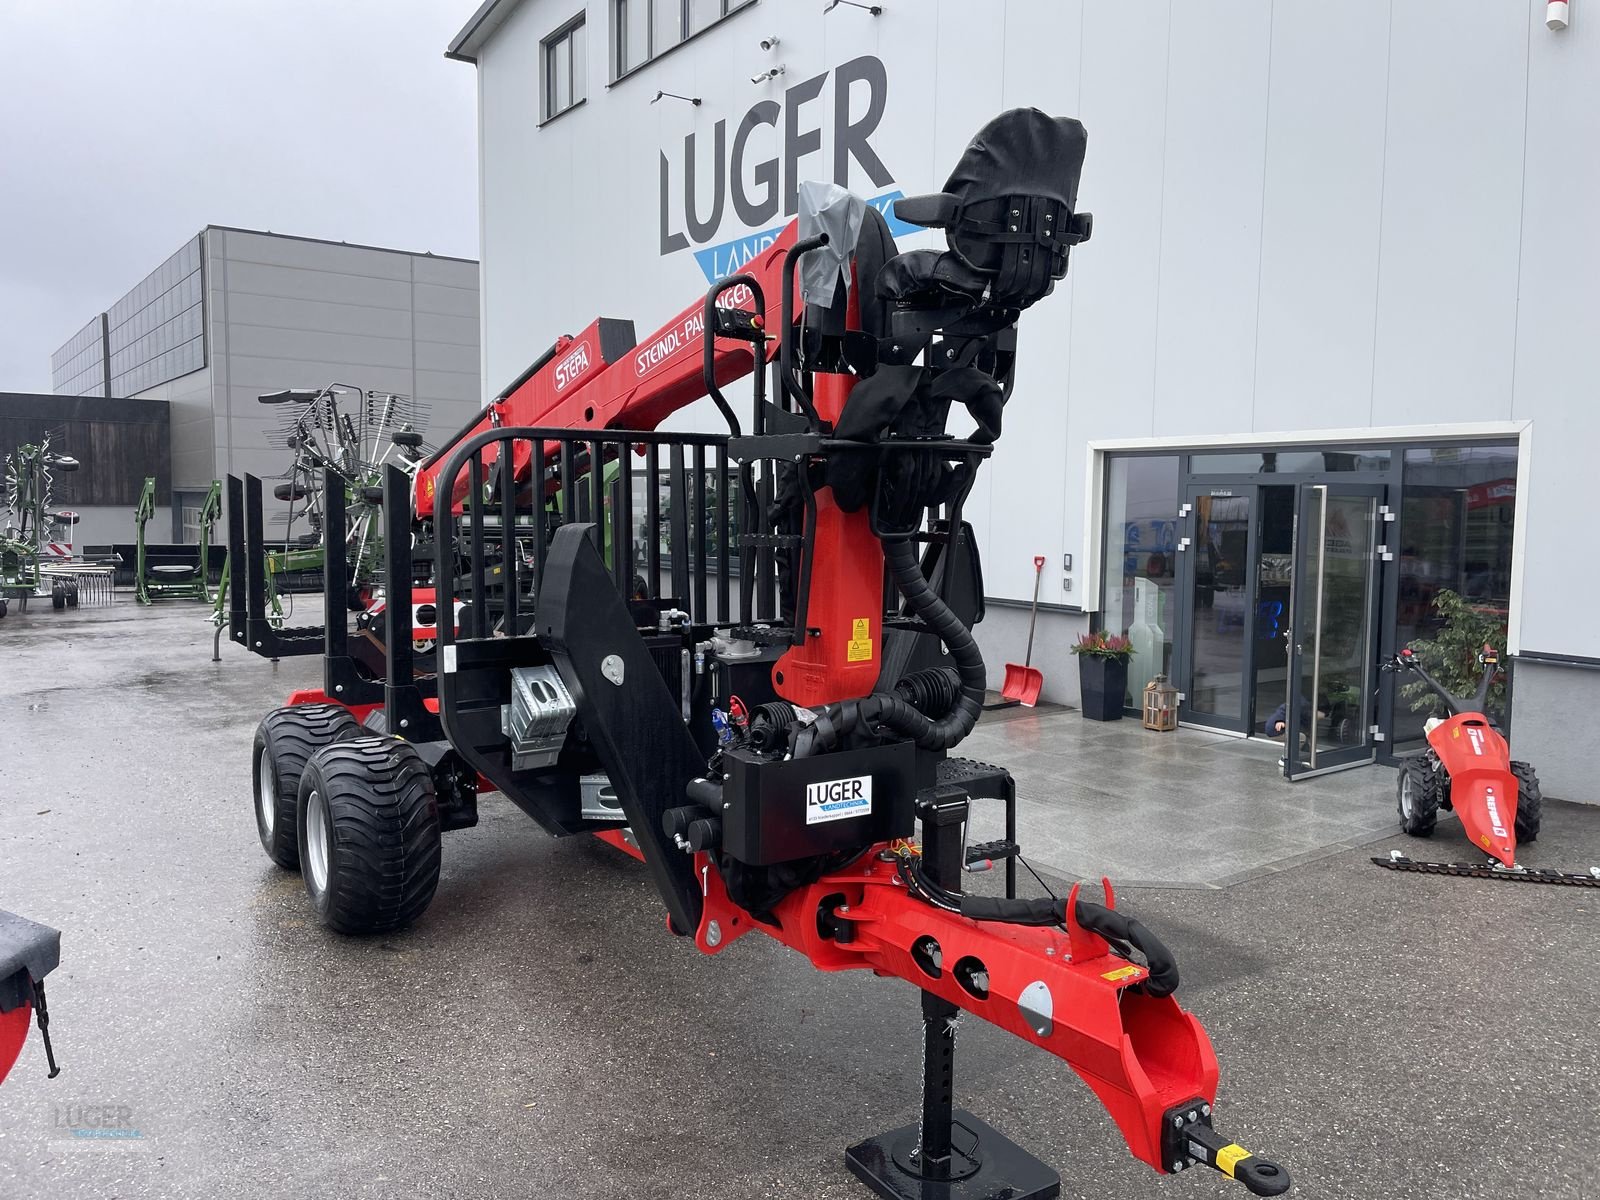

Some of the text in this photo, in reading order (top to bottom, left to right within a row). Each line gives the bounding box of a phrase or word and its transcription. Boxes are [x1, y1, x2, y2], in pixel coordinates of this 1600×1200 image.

[660, 55, 896, 256] LUGER
[555, 350, 589, 390] STEPA
[808, 780, 863, 806] LUGER
